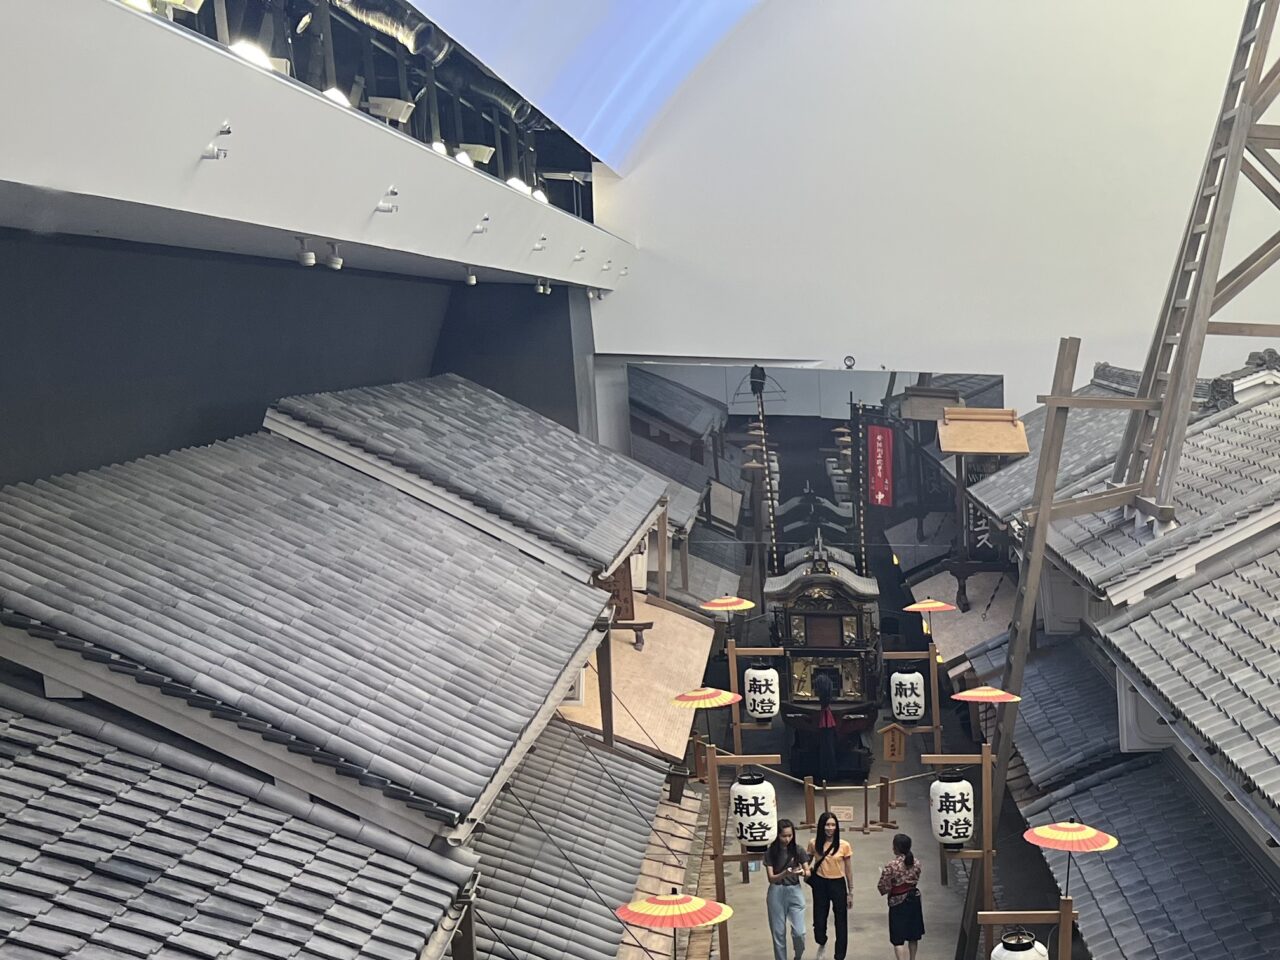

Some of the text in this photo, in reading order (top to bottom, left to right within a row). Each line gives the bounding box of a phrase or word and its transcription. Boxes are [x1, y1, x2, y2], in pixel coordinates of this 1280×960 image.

[748, 677, 776, 714] 献燈
[895, 682, 922, 717] 献燈
[734, 795, 771, 841] 献燈
[939, 792, 971, 839] 献燈
